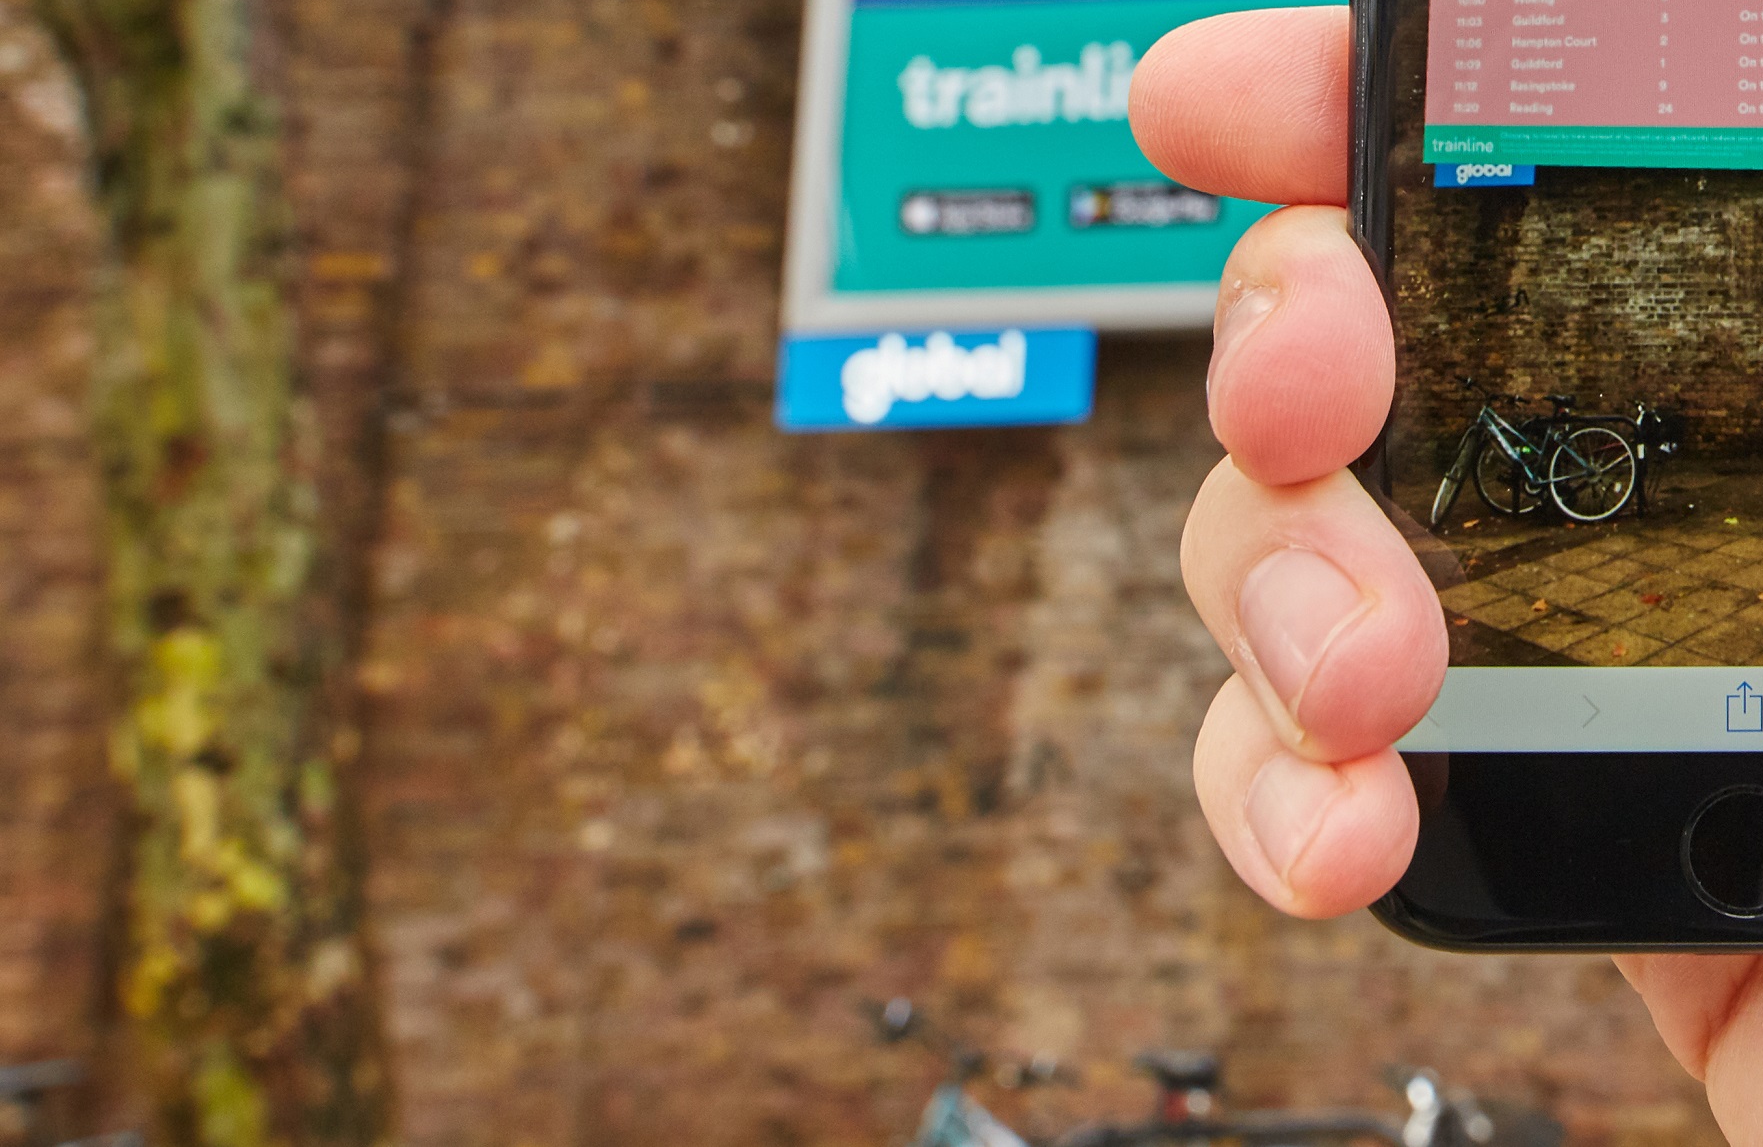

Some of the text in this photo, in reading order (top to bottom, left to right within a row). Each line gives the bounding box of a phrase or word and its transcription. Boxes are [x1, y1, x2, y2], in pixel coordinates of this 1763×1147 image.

[1740, 10, 1757, 21] On
[1564, 36, 1597, 47] Court
[1739, 33, 1757, 45] On
[1739, 56, 1756, 68] On
[1738, 79, 1756, 91] On
[1738, 102, 1755, 114] On
[1432, 138, 1494, 153] trainline
[842, 331, 1027, 424] global
